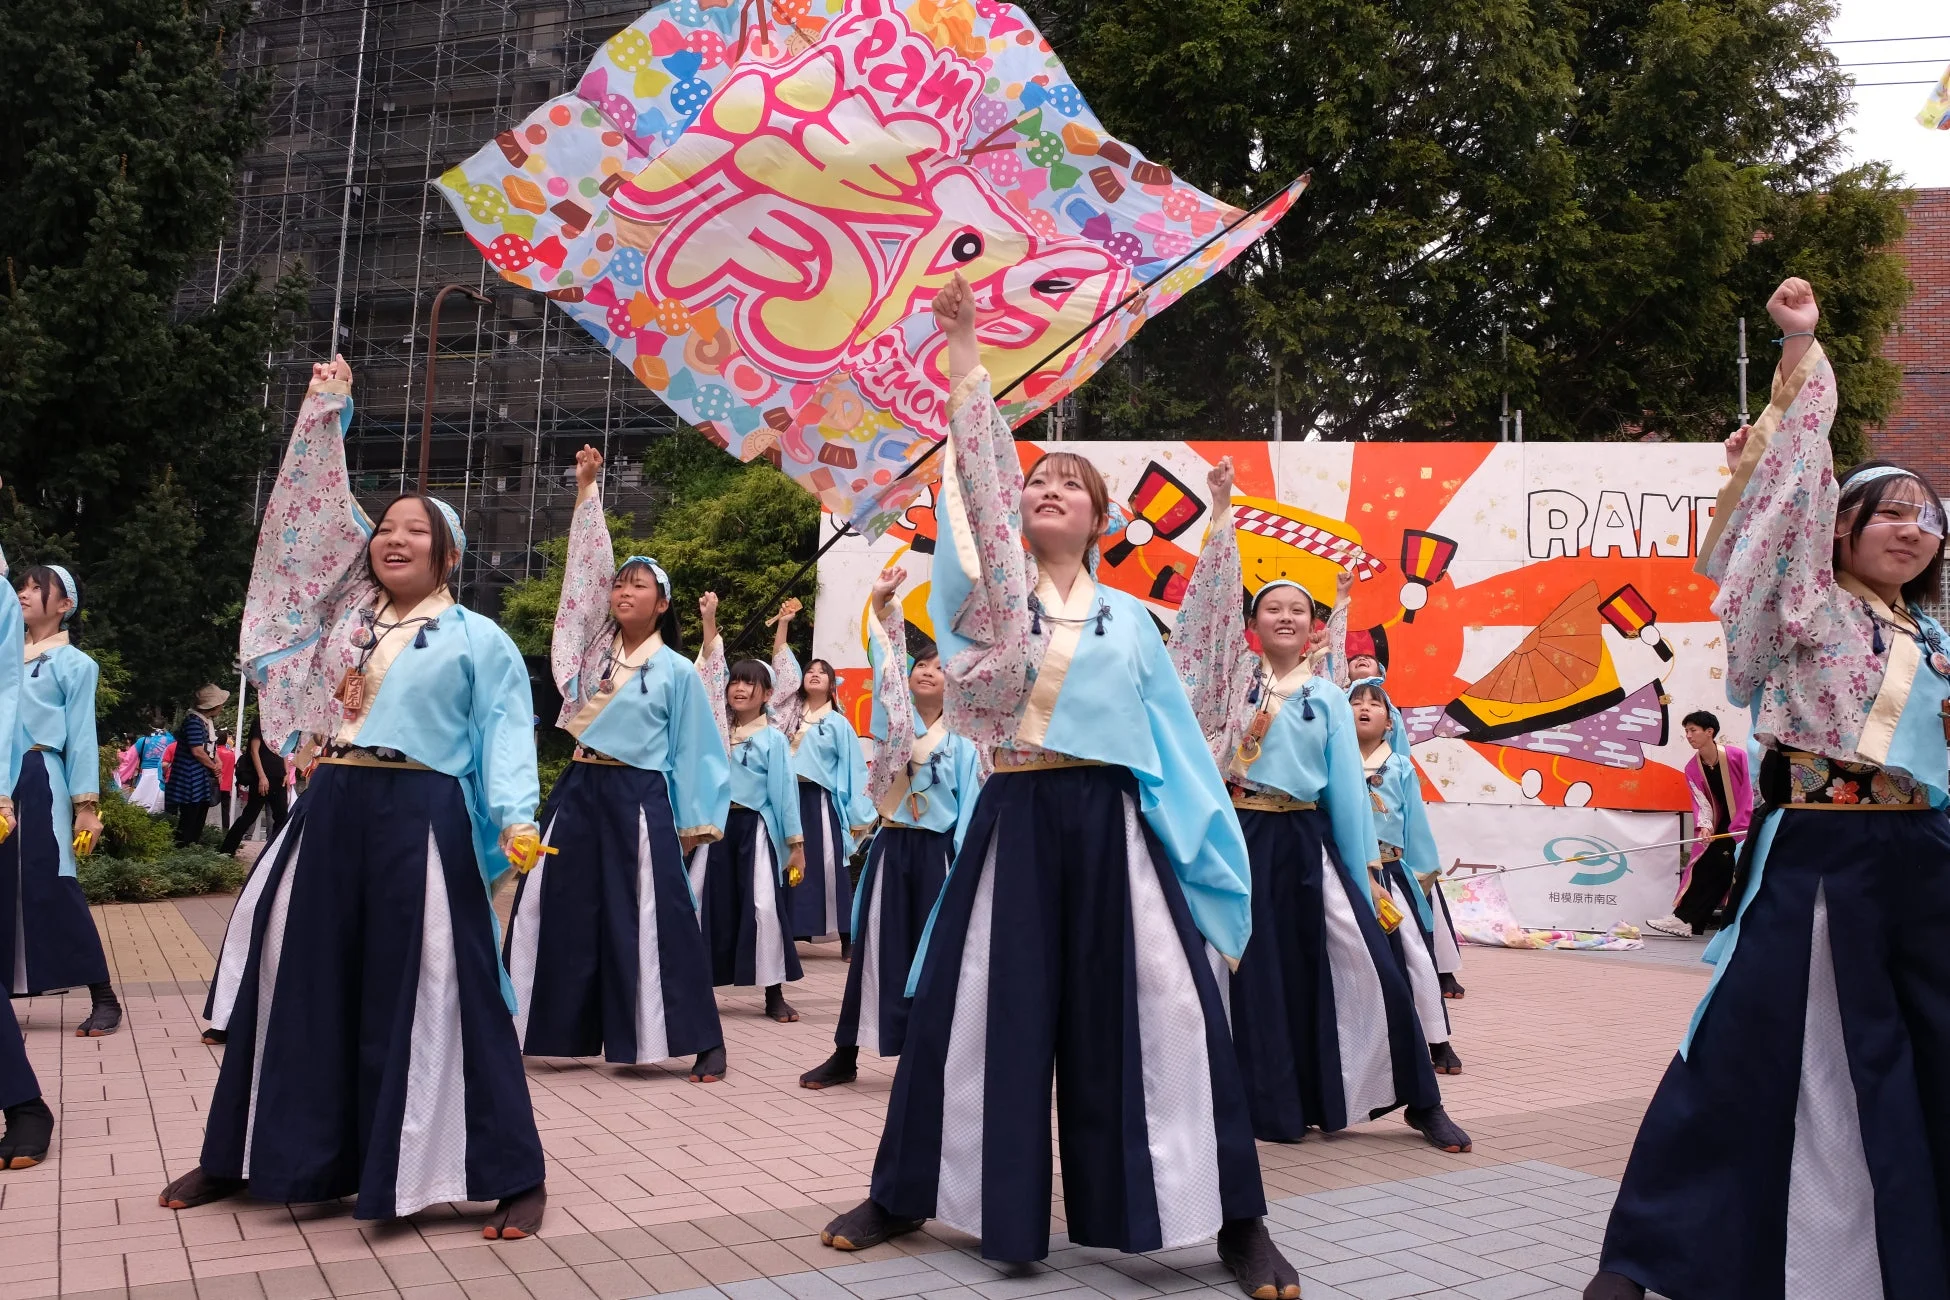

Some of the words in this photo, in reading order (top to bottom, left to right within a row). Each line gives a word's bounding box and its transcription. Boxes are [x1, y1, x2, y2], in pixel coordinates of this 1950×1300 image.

[1548, 891, 1618, 906] 相模原市南区
